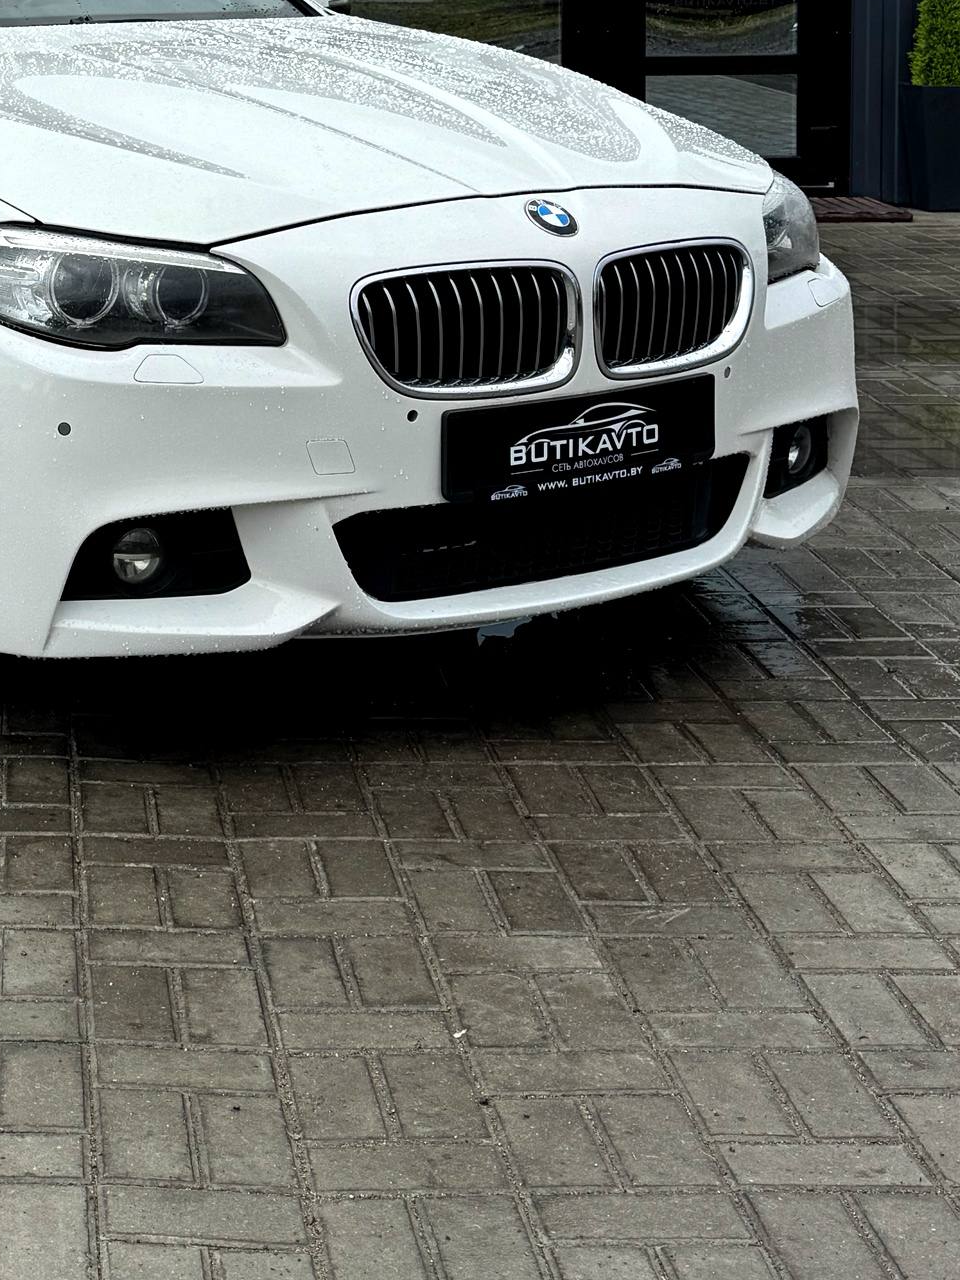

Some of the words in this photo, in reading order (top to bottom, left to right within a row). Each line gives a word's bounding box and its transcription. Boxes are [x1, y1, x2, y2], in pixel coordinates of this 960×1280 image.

[510, 424, 659, 466] BUTIKAVTO
[552, 462, 572, 472] СЕТЬ
[573, 454, 624, 470] АВТОХАУСОВ
[537, 480, 568, 491] WWW.
[572, 466, 644, 487] BUTIKAVTO.BY
